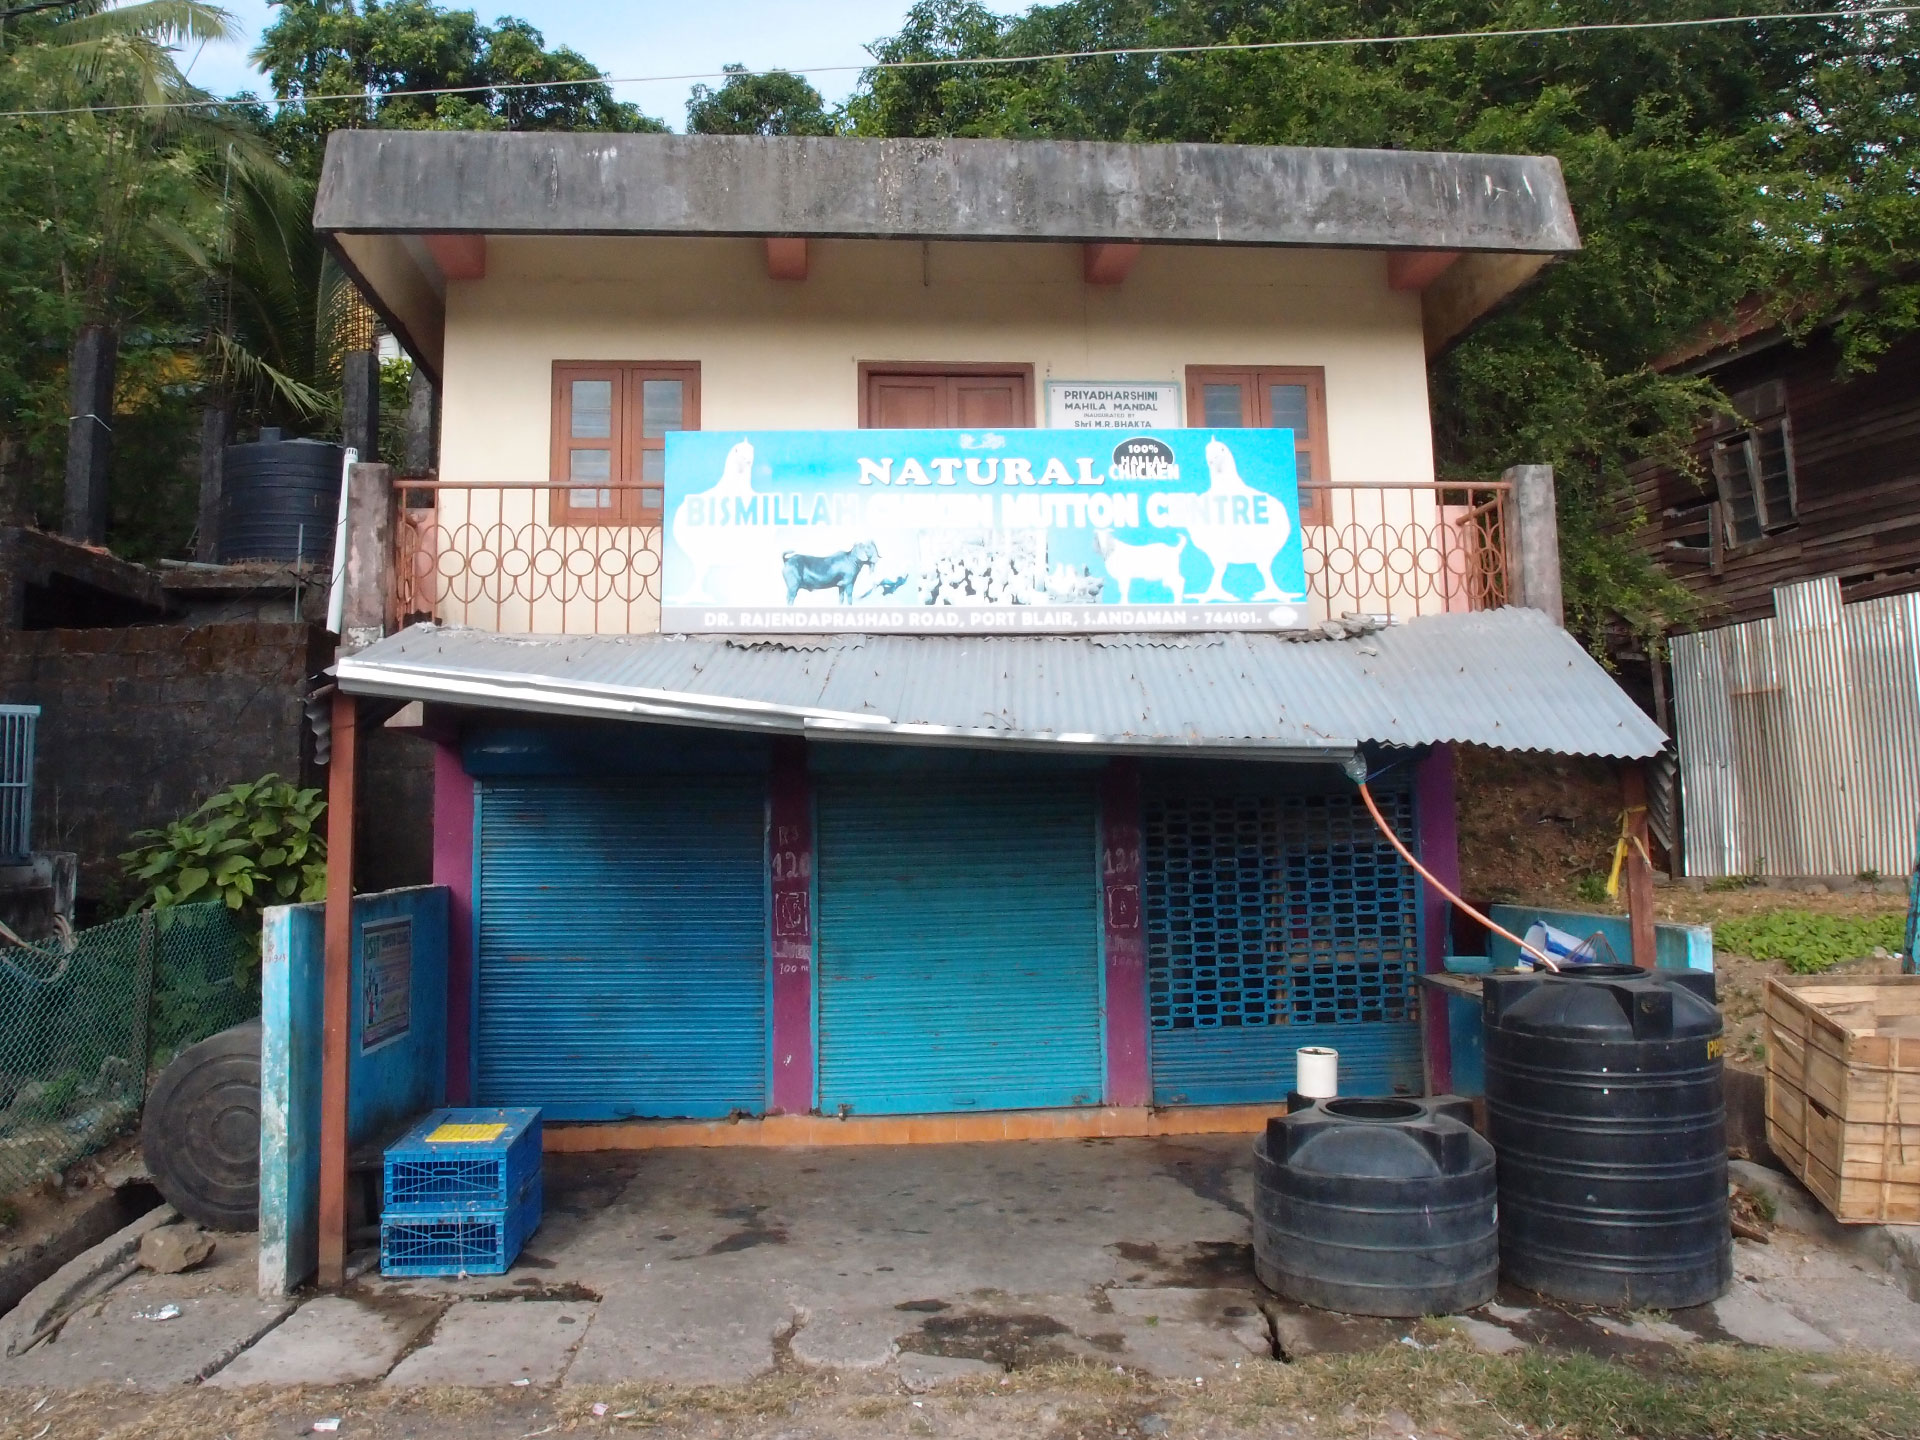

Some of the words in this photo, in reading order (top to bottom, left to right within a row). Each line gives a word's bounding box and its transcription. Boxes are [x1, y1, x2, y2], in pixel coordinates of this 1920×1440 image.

[1064, 390, 1158, 401] PRIYADHARSHINI
[1064, 402, 1106, 411] MAHILA
[1113, 403, 1158, 411] MANDAL
[1074, 420, 1092, 428] Shri
[1128, 444, 1159, 454] 100%
[856, 457, 1106, 486] NATURAL
[1109, 463, 1180, 481] CHICKEN
[685, 494, 859, 527] BISMILLAH
[1001, 492, 1139, 528] MUTTON
[1147, 492, 1271, 528] CNTRE
[704, 612, 735, 627] DR.
[740, 612, 904, 627] RAJENDAPRASHAD
[908, 612, 965, 628] ROAD,
[970, 611, 1015, 626] PORT
[1022, 611, 1078, 627] BLAIR,
[1083, 610, 1187, 626] S.ANDAMAN
[1204, 610, 1262, 625] 744101.
